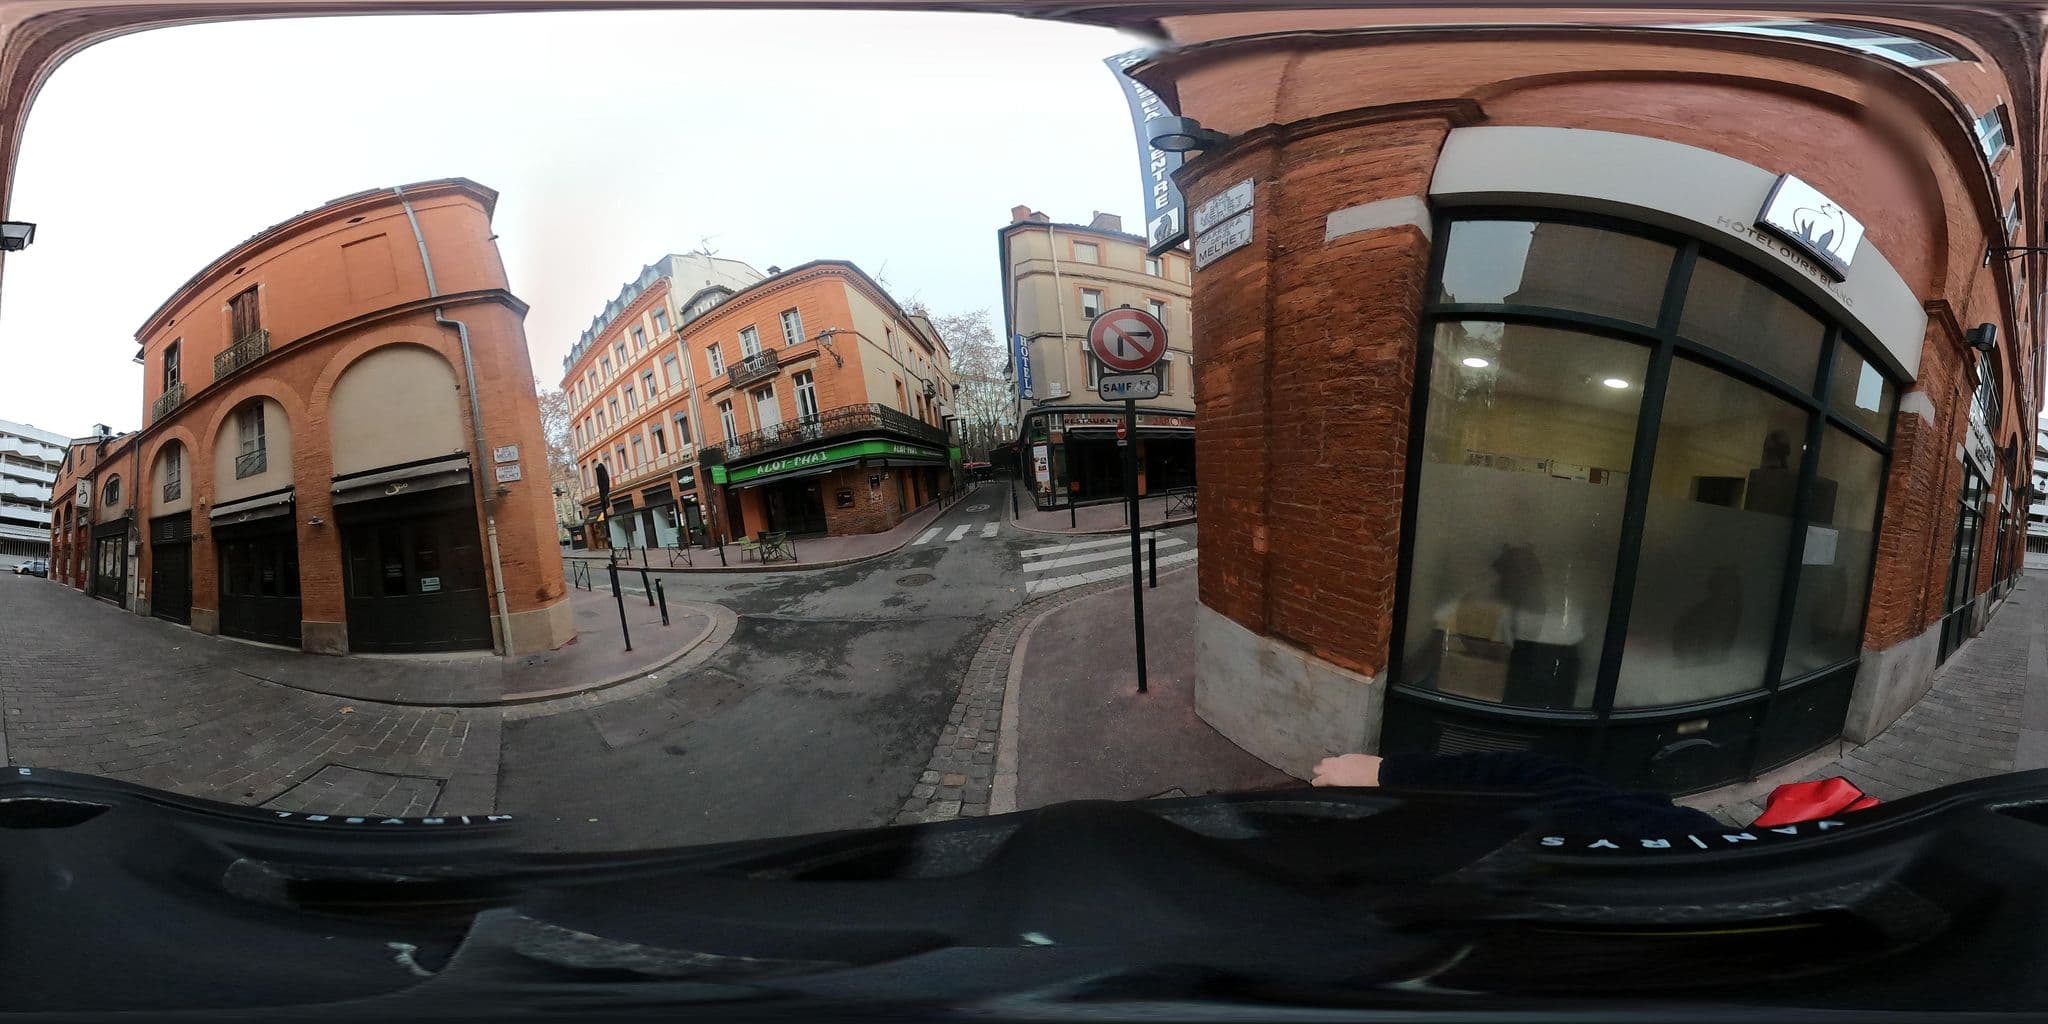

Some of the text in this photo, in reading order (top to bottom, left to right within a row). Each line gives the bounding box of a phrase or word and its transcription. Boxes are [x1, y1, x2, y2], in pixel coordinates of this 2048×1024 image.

[1149, 146, 1169, 210] ENTRE
[1199, 229, 1247, 262] MELHET
[1779, 247, 1817, 277] OURS
[1819, 273, 1854, 308] BLANC
[1020, 335, 1032, 389] HOTEL
[1103, 382, 1132, 393] SAUF
